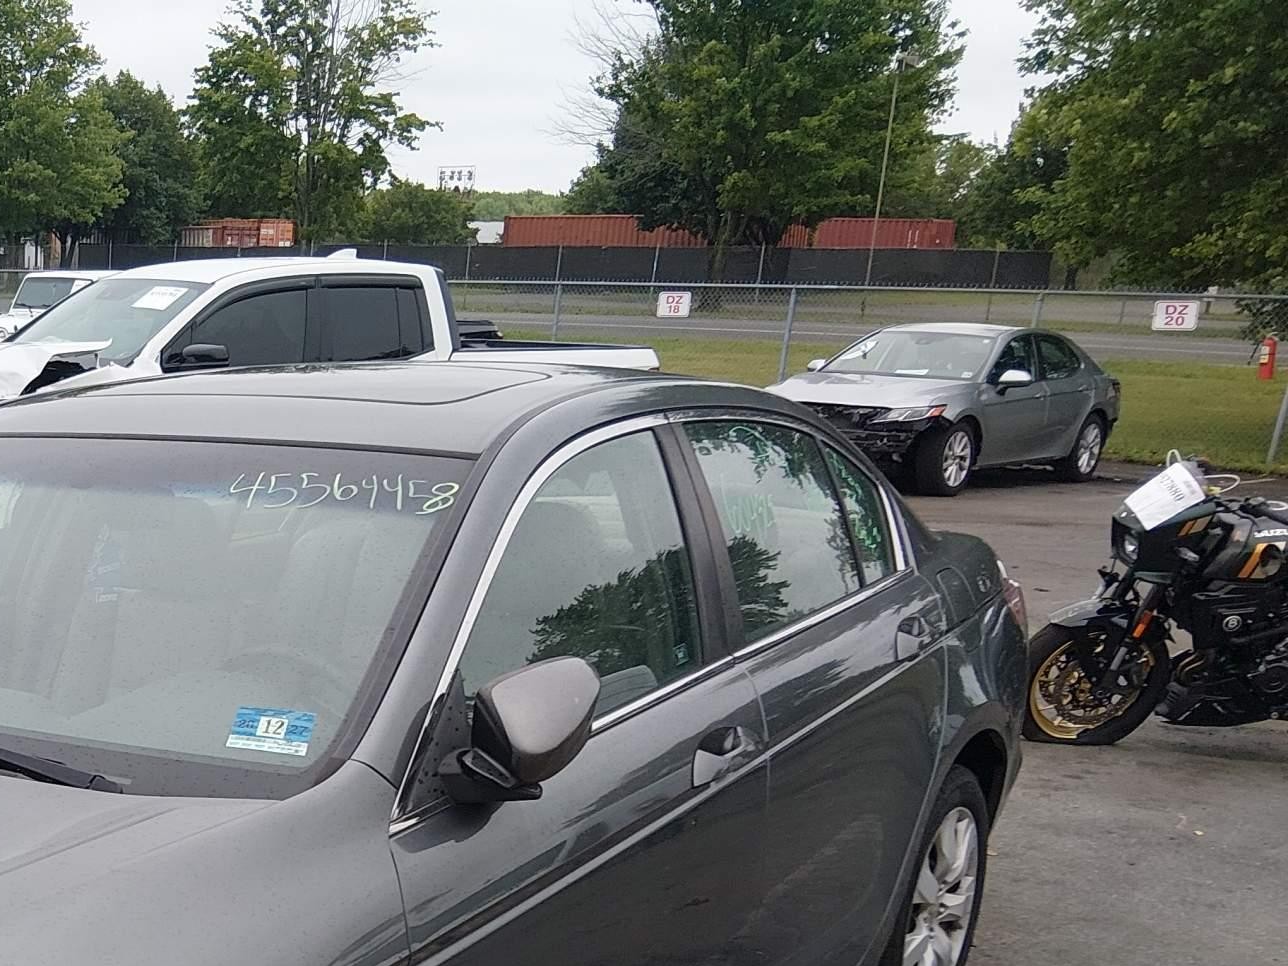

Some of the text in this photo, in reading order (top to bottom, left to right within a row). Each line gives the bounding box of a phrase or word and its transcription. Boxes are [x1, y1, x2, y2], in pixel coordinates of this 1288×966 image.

[666, 295, 684, 305] DZ
[667, 305, 680, 314] 18
[1165, 304, 1190, 316] DZ
[1164, 316, 1185, 326] 20
[229, 471, 460, 515] 45564458
[262, 718, 285, 735] 12
